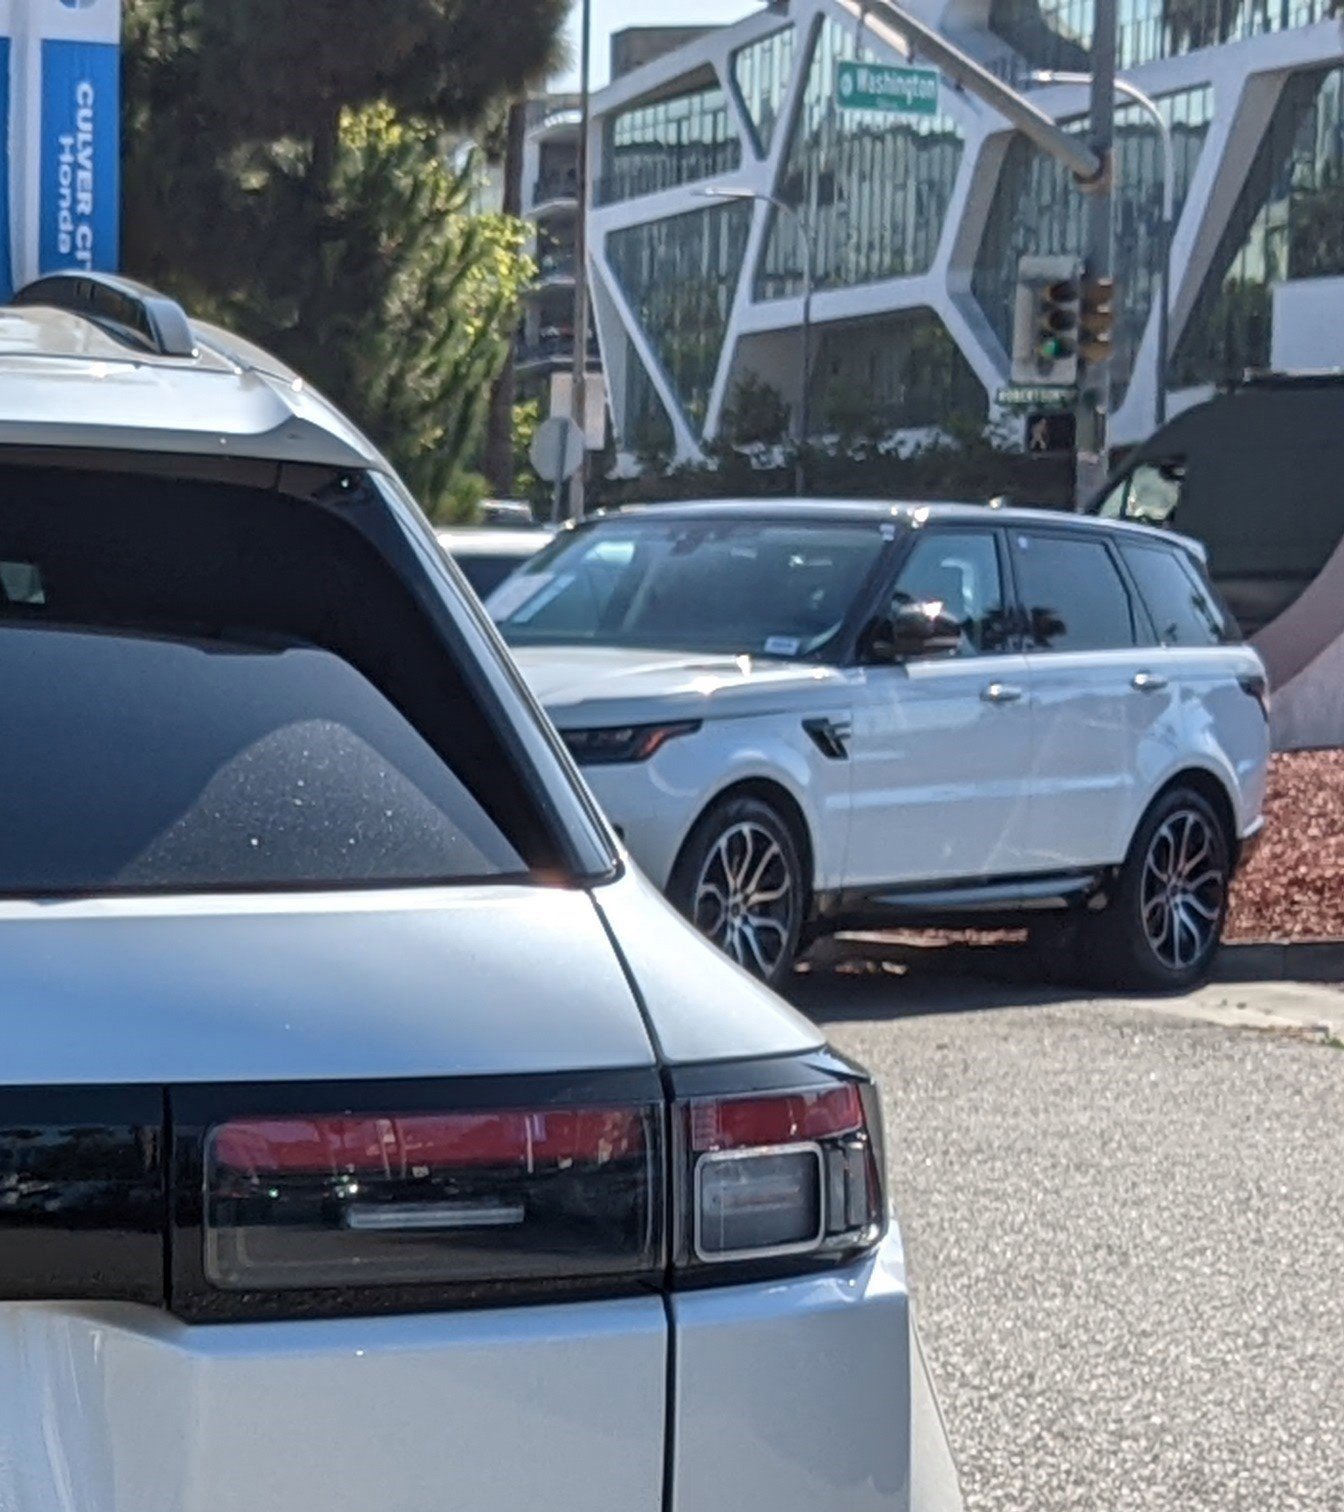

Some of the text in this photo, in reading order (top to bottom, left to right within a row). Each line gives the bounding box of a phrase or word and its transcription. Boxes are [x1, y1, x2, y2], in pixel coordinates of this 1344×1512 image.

[856, 67, 936, 106] Washington
[58, 135, 75, 254] Honda
[75, 80, 94, 216] CULVER
